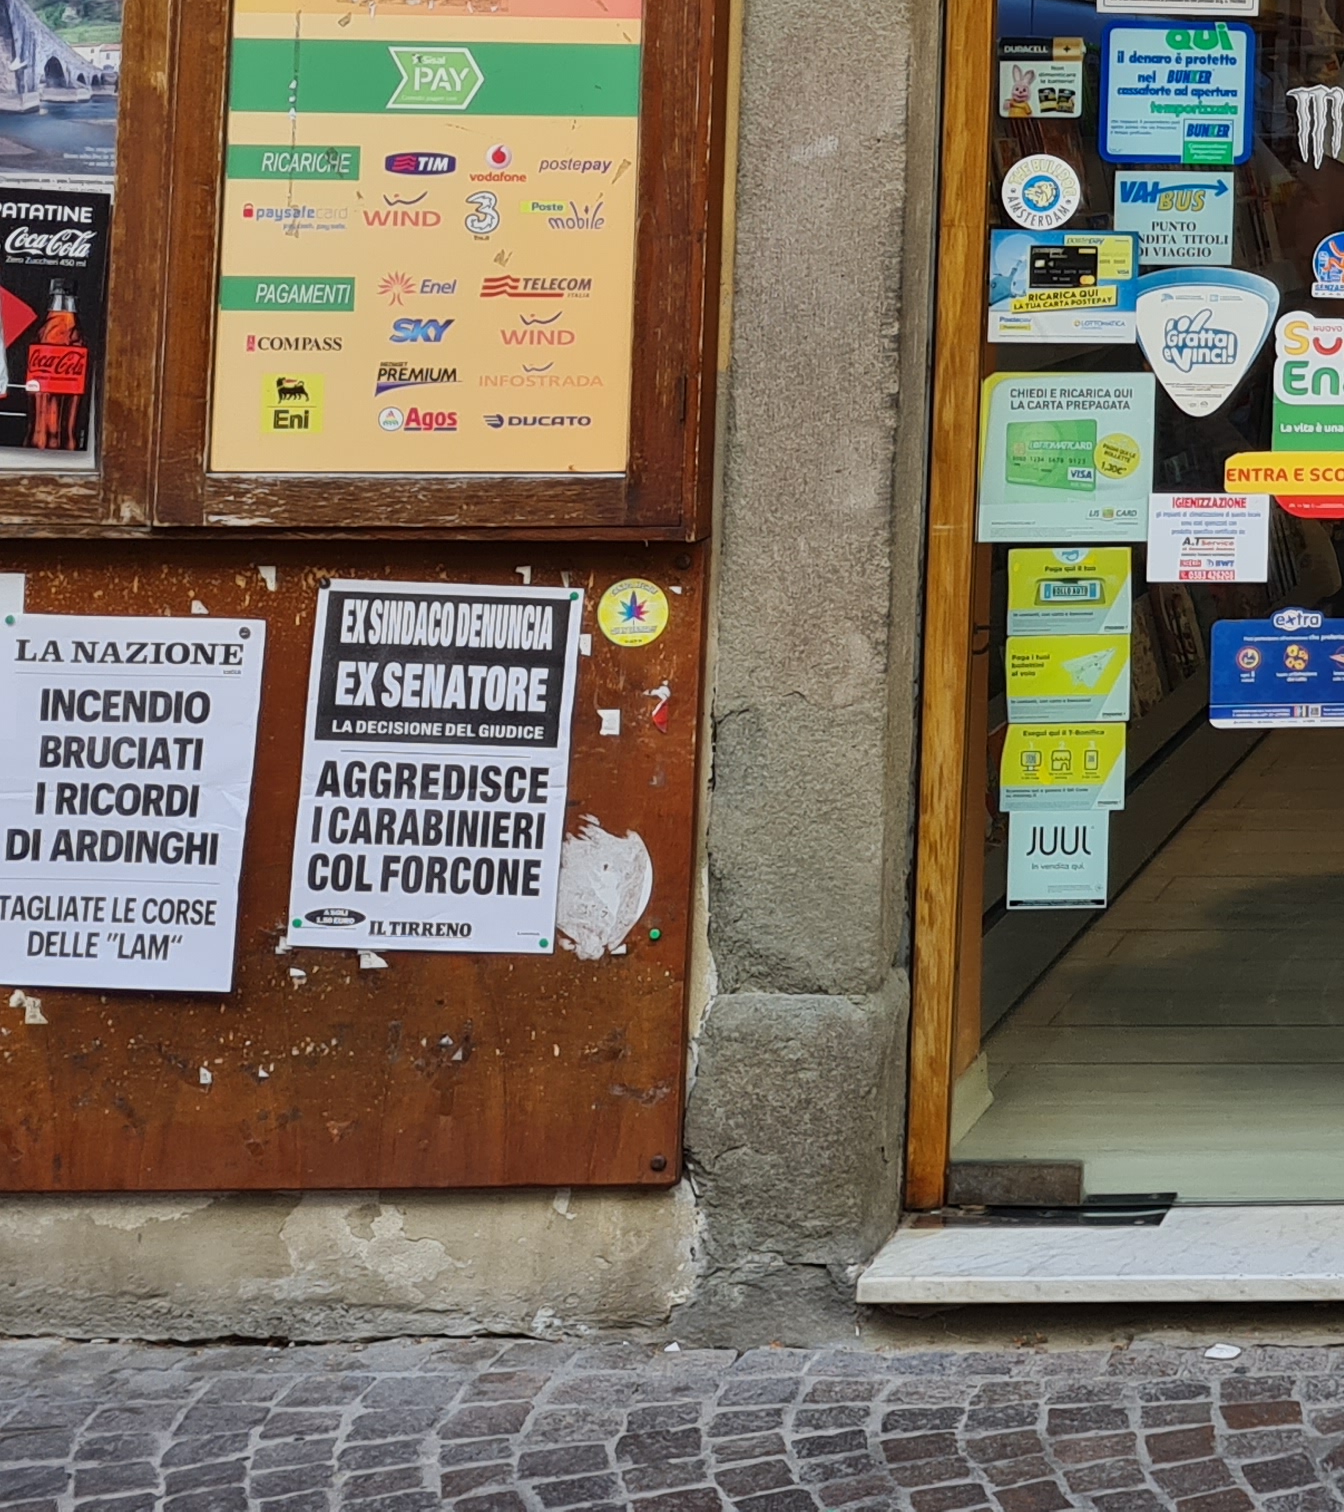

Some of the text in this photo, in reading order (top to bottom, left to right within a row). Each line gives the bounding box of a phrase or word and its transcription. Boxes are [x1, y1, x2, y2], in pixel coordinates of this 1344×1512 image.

[1003, 44, 1049, 54] DURACELL
[1116, 50, 1125, 64] il
[1128, 50, 1172, 65] denaro
[1185, 51, 1237, 68] protetto
[413, 66, 470, 92] PAY
[1137, 69, 1212, 85] nel BUNKER
[1117, 84, 1238, 100] cassaforte ad apertura
[1150, 101, 1239, 118] temporizzata
[1186, 123, 1231, 138] BUNKER
[261, 152, 612, 183] RICARICHE TIM vodafone postepay
[1007, 195, 1071, 228] AMSTERDAM
[1151, 221, 1197, 232] PUNTO
[1182, 234, 1229, 245] TITOLI
[1153, 247, 1212, 258] VIAGGIO
[255, 277, 593, 305] PAGAMENTI Enel TELECOM
[1028, 288, 1099, 302] RICARICA QUI
[389, 317, 576, 346] SKY WIND
[1166, 329, 1229, 346] Gratta
[257, 336, 343, 351] COMPASS
[377, 366, 604, 388] PREMIUM INFOSTRADA
[1010, 388, 1133, 399] CHIEDI E RICARICA QUI
[1010, 400, 1131, 411] LA CARTA PREPAGATA
[273, 406, 592, 432] Eni Agos DUCATO
[1226, 468, 1289, 482] ENTRA
[1293, 468, 1305, 482] E
[1171, 496, 1248, 509] IGIENIZZAZIONE
[340, 598, 553, 652] EX SINDACO DENUNCIA
[14, 637, 245, 668] LA NAZIONE
[333, 659, 549, 714] EX SENATORE
[39, 687, 212, 724] INCENDIO
[331, 718, 545, 740] LA DECISIONE DEL GIUDICE
[38, 734, 204, 772] BRUCIATI
[315, 758, 550, 805] AGGREDISCE
[34, 781, 200, 819] I RICORDI
[310, 806, 547, 851] I CARABINIERI
[5, 828, 220, 867] DI ARDINGHI
[1026, 825, 1092, 857] JUUL
[307, 852, 542, 897] COL FORCONE
[0, 895, 217, 927] TAGLIATE LE CORSE
[368, 920, 472, 938] IL TIRRENO
